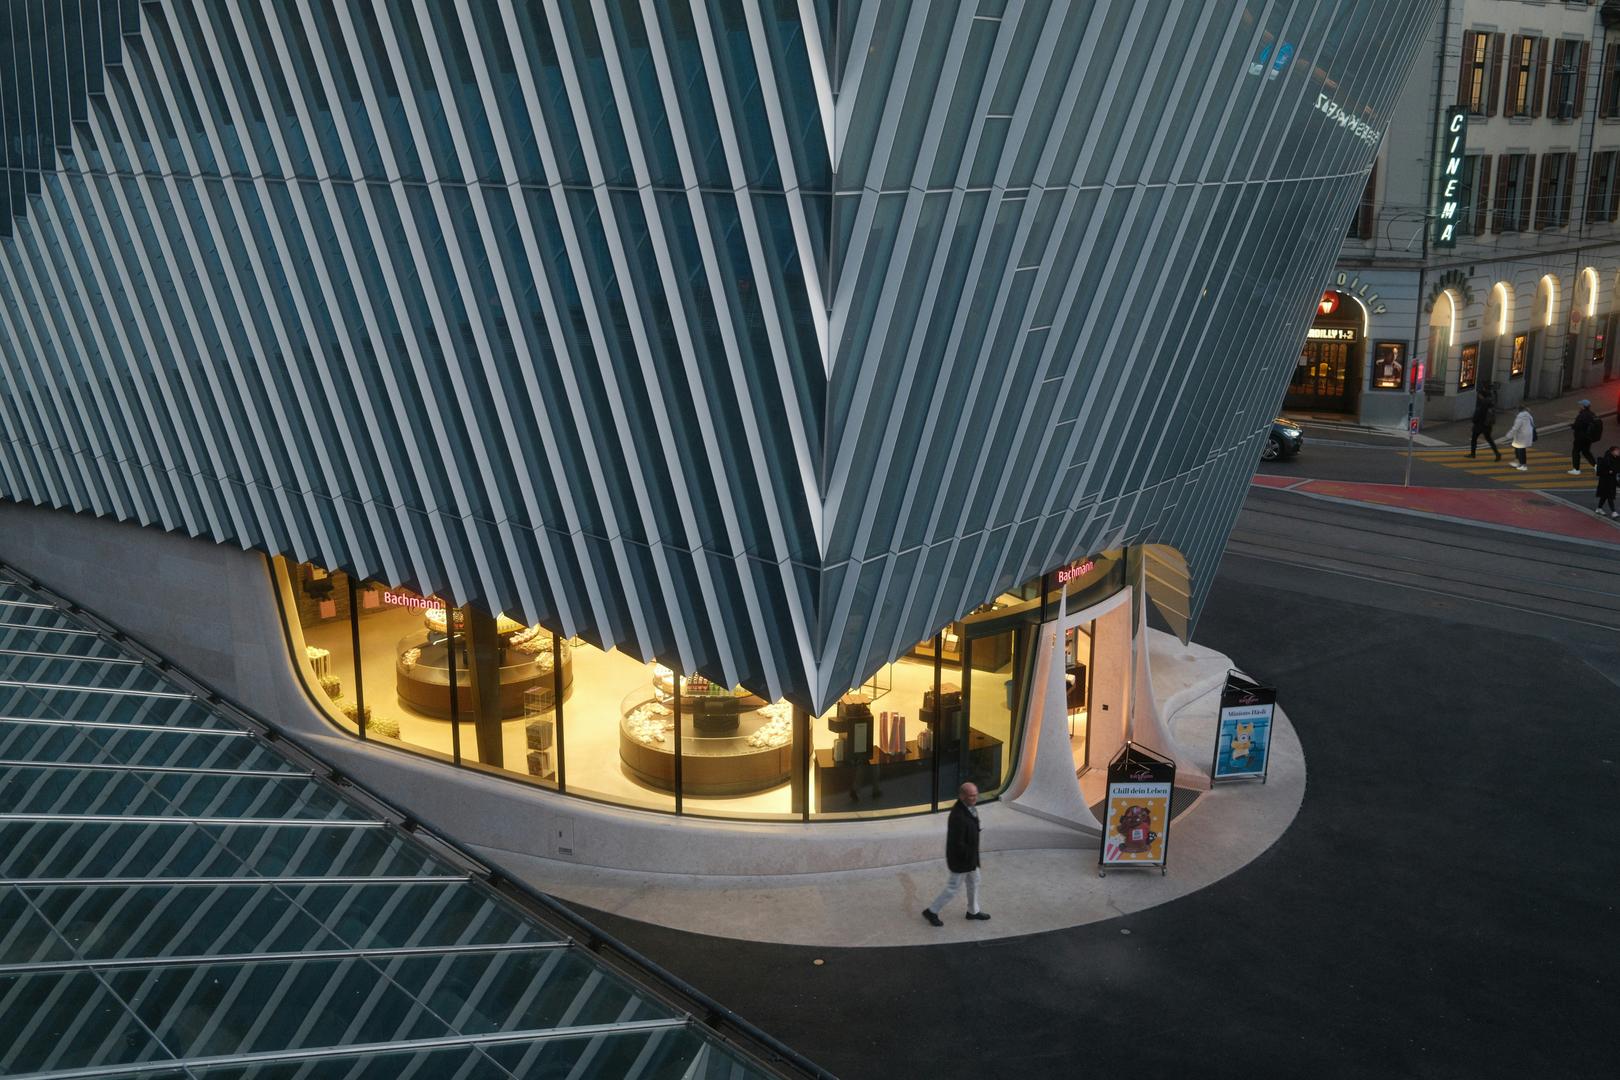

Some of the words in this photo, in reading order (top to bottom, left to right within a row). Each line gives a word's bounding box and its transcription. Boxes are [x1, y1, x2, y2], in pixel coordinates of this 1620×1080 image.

[1440, 114, 1463, 241] CINEMA
[1338, 329, 1354, 340] 1+2
[1058, 561, 1094, 583] Bachmann
[384, 591, 441, 610] Bachmann
[1112, 787, 1130, 795] Chill
[1130, 787, 1146, 795] dein
[1146, 787, 1168, 795] Leben
